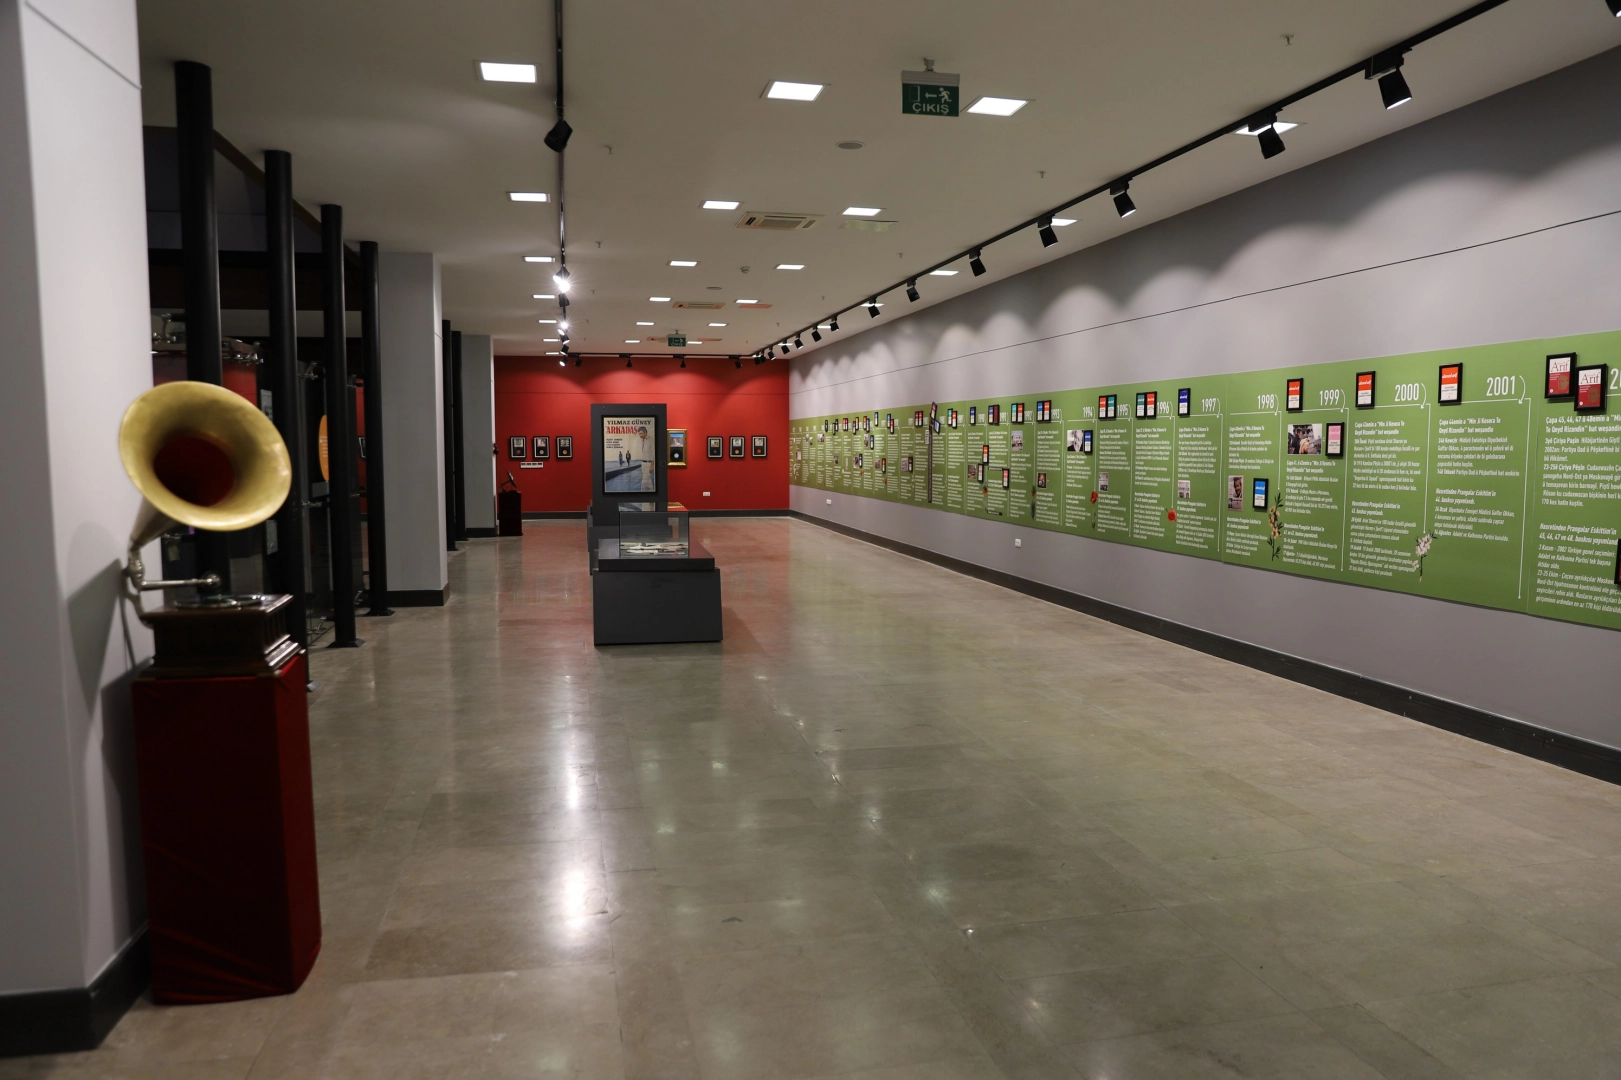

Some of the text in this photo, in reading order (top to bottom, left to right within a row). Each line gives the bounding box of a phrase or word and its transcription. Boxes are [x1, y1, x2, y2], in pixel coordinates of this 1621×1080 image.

[912, 102, 949, 115] ÇIKIŞ
[1580, 371, 1600, 384] Arif
[1394, 383, 1419, 402] 2000
[1486, 376, 1516, 396] 2001
[1258, 394, 1274, 410] 1998
[1320, 389, 1340, 406] 1999
[1117, 404, 1128, 416] 1995
[1157, 401, 1169, 414] 1996
[1202, 398, 1216, 412] 1997
[606, 426, 638, 435] ARKADAŞ
